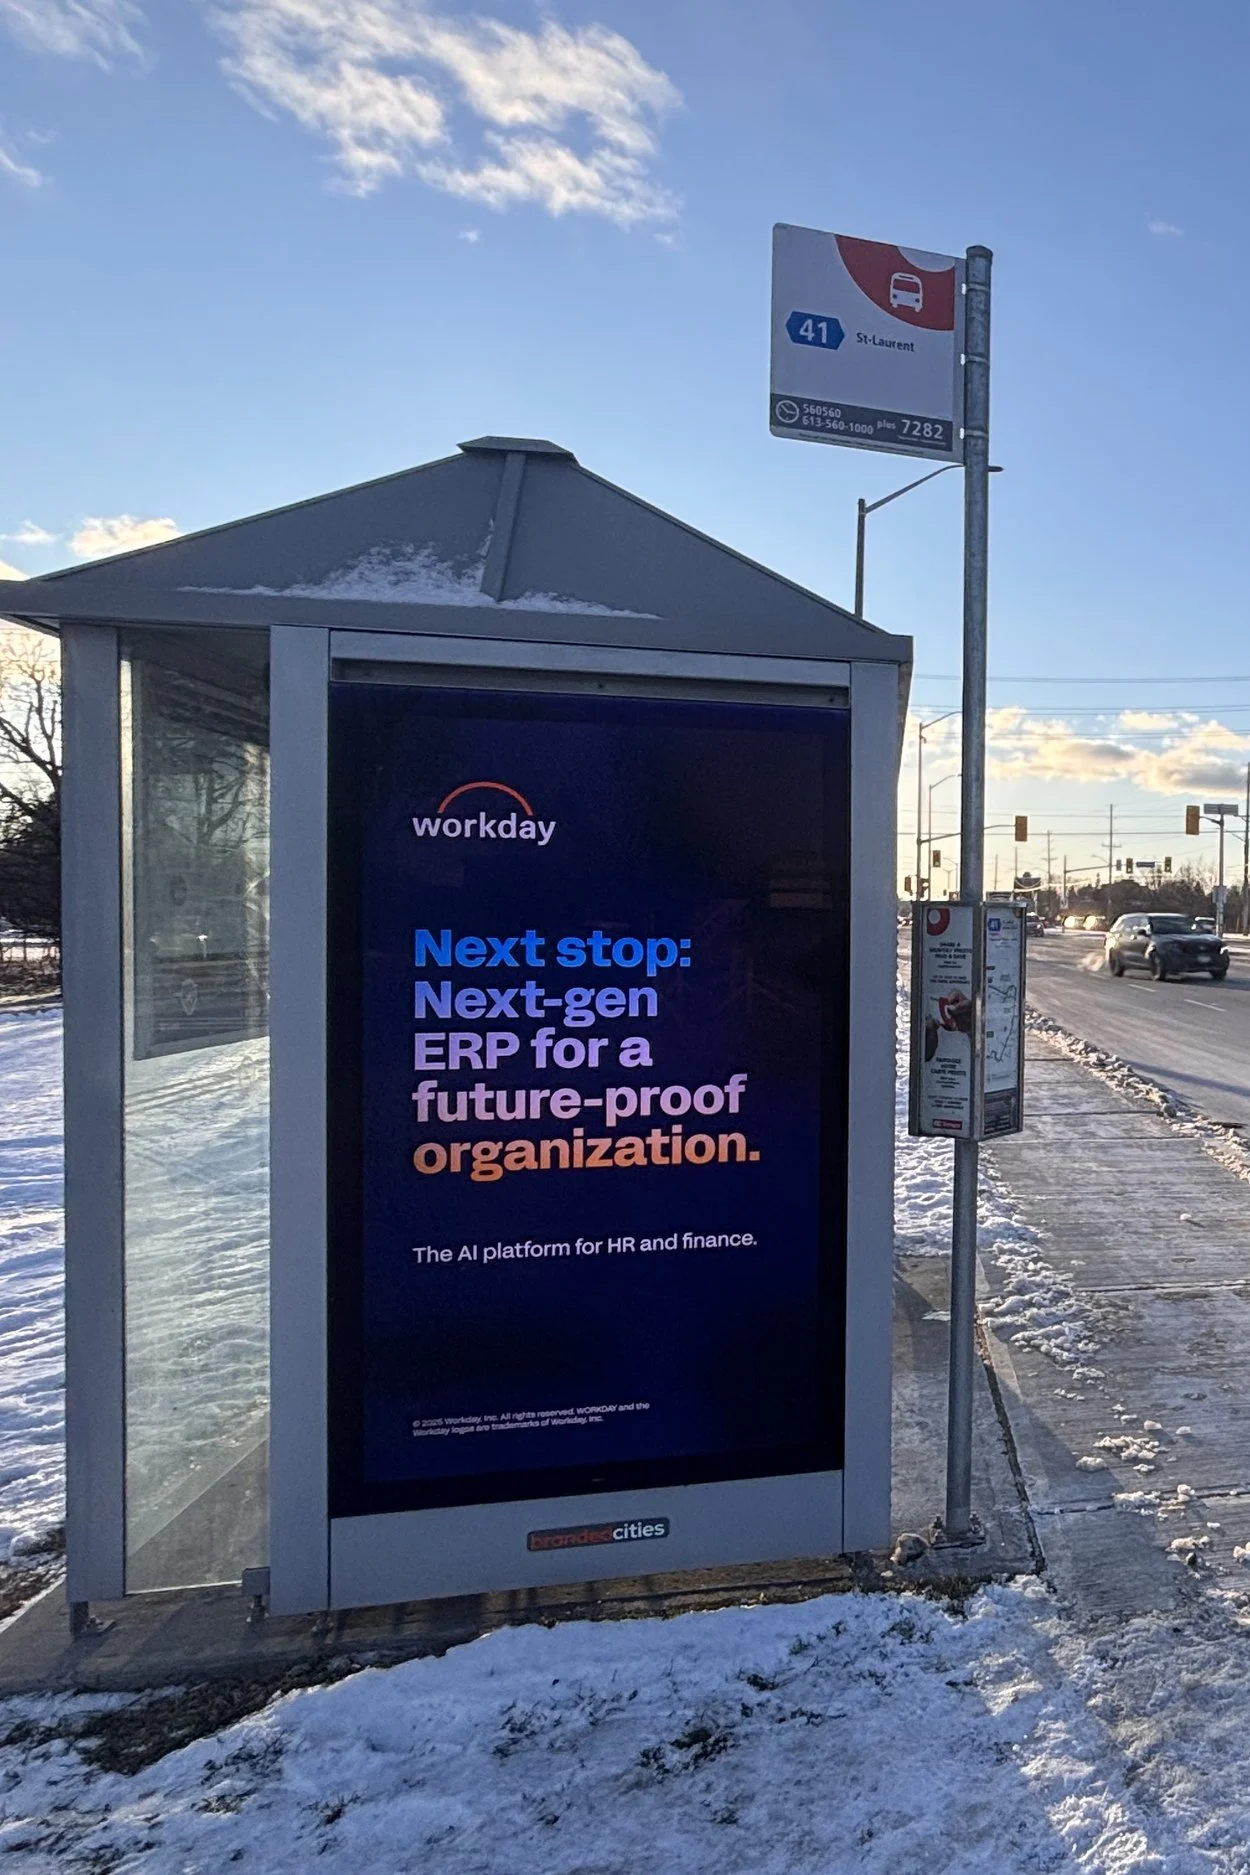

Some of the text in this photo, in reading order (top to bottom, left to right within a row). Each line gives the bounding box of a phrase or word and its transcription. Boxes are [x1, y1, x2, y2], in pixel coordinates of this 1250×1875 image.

[799, 319, 915, 352] 41 St-Laurent
[803, 404, 842, 418] 560560
[802, 416, 944, 440] 613-560-1000 plus 7282
[412, 813, 557, 846] workday
[414, 928, 692, 977] Next stop:
[414, 980, 658, 1028] Next-gen
[414, 1027, 654, 1071] ERP for a
[411, 1073, 748, 1127] future-proof
[413, 1125, 760, 1182] organization.
[411, 1231, 758, 1264] The AI platform for HR and finance.
[412, 1428, 451, 1437] Workday
[491, 1420, 540, 1431] trademarks
[540, 1418, 550, 1427] of
[500, 1412, 511, 1421] All
[511, 1411, 536, 1421] rights
[576, 1405, 618, 1415] WORKDAY
[618, 1403, 635, 1411] and
[635, 1402, 650, 1410] the
